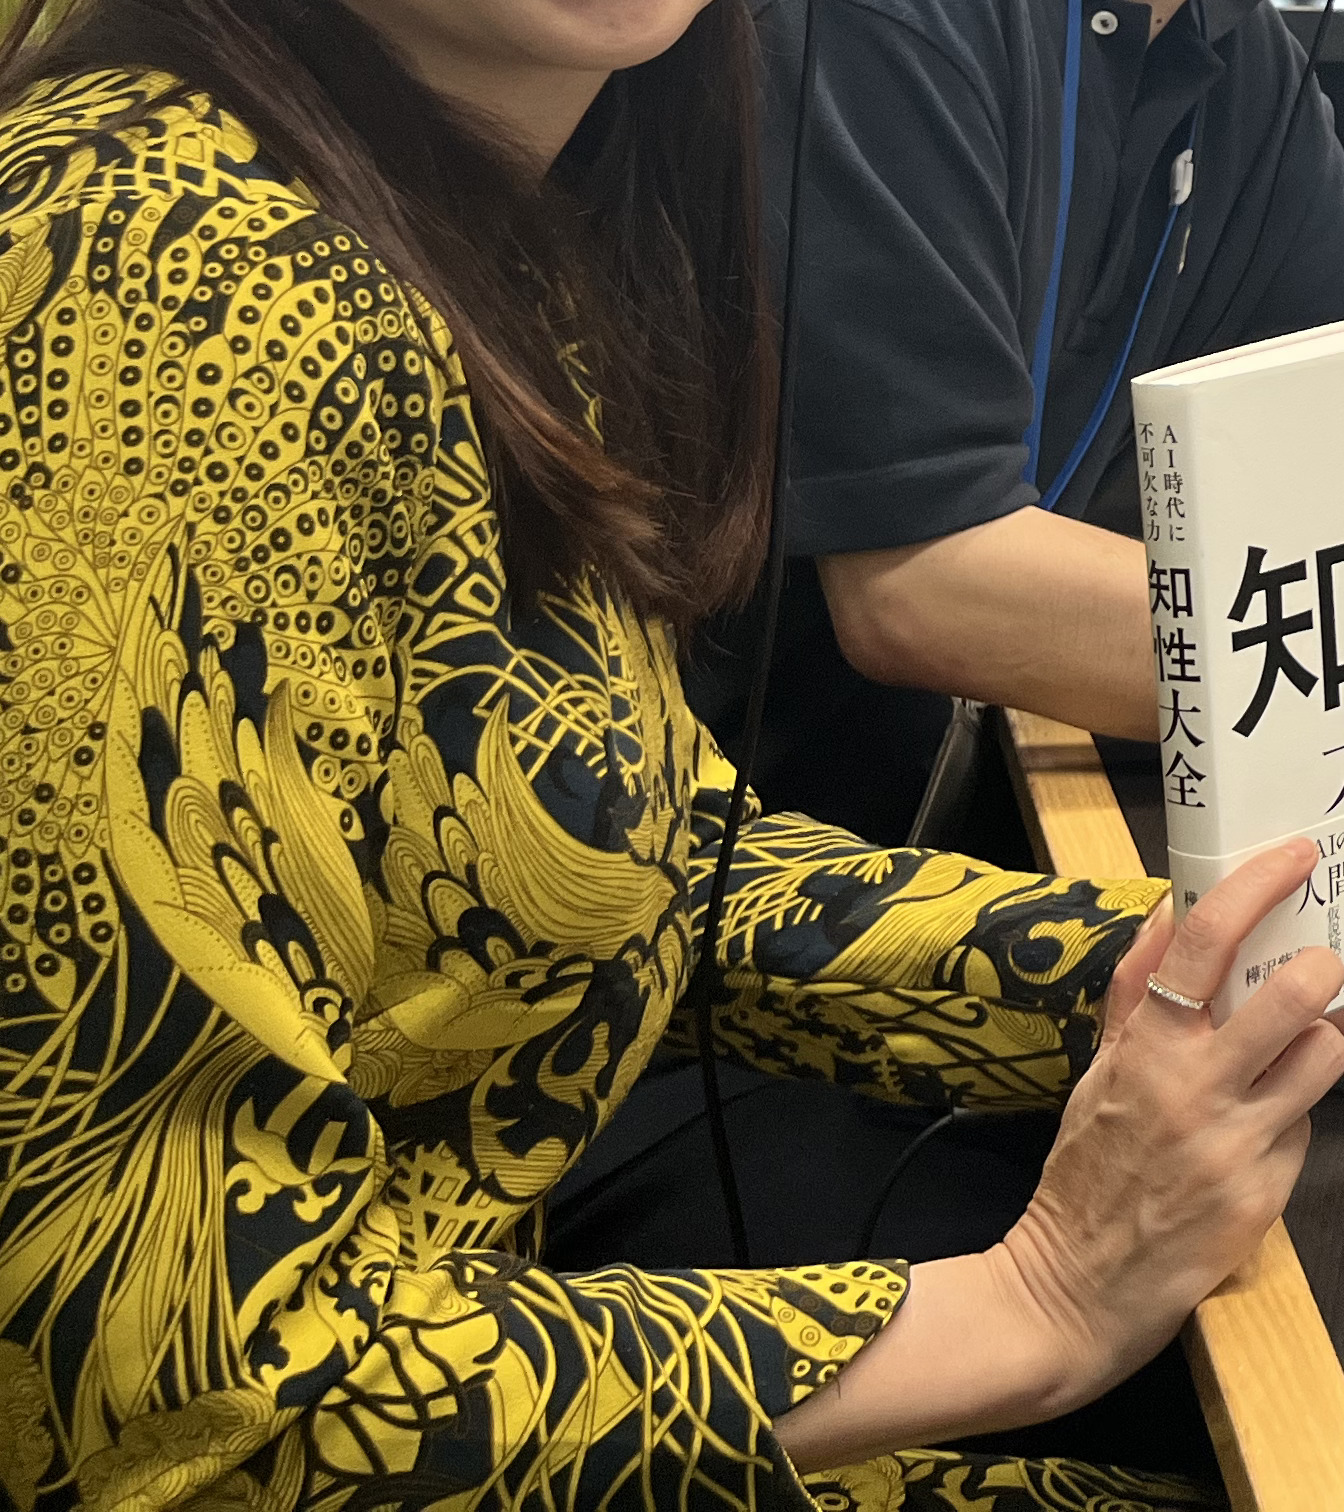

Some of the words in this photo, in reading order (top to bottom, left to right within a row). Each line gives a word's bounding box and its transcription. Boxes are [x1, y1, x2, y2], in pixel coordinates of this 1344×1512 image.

[1138, 422, 1161, 542] 不可欠な力
[1162, 424, 1186, 542] AI時代に
[1147, 559, 1207, 810] 知性大全
